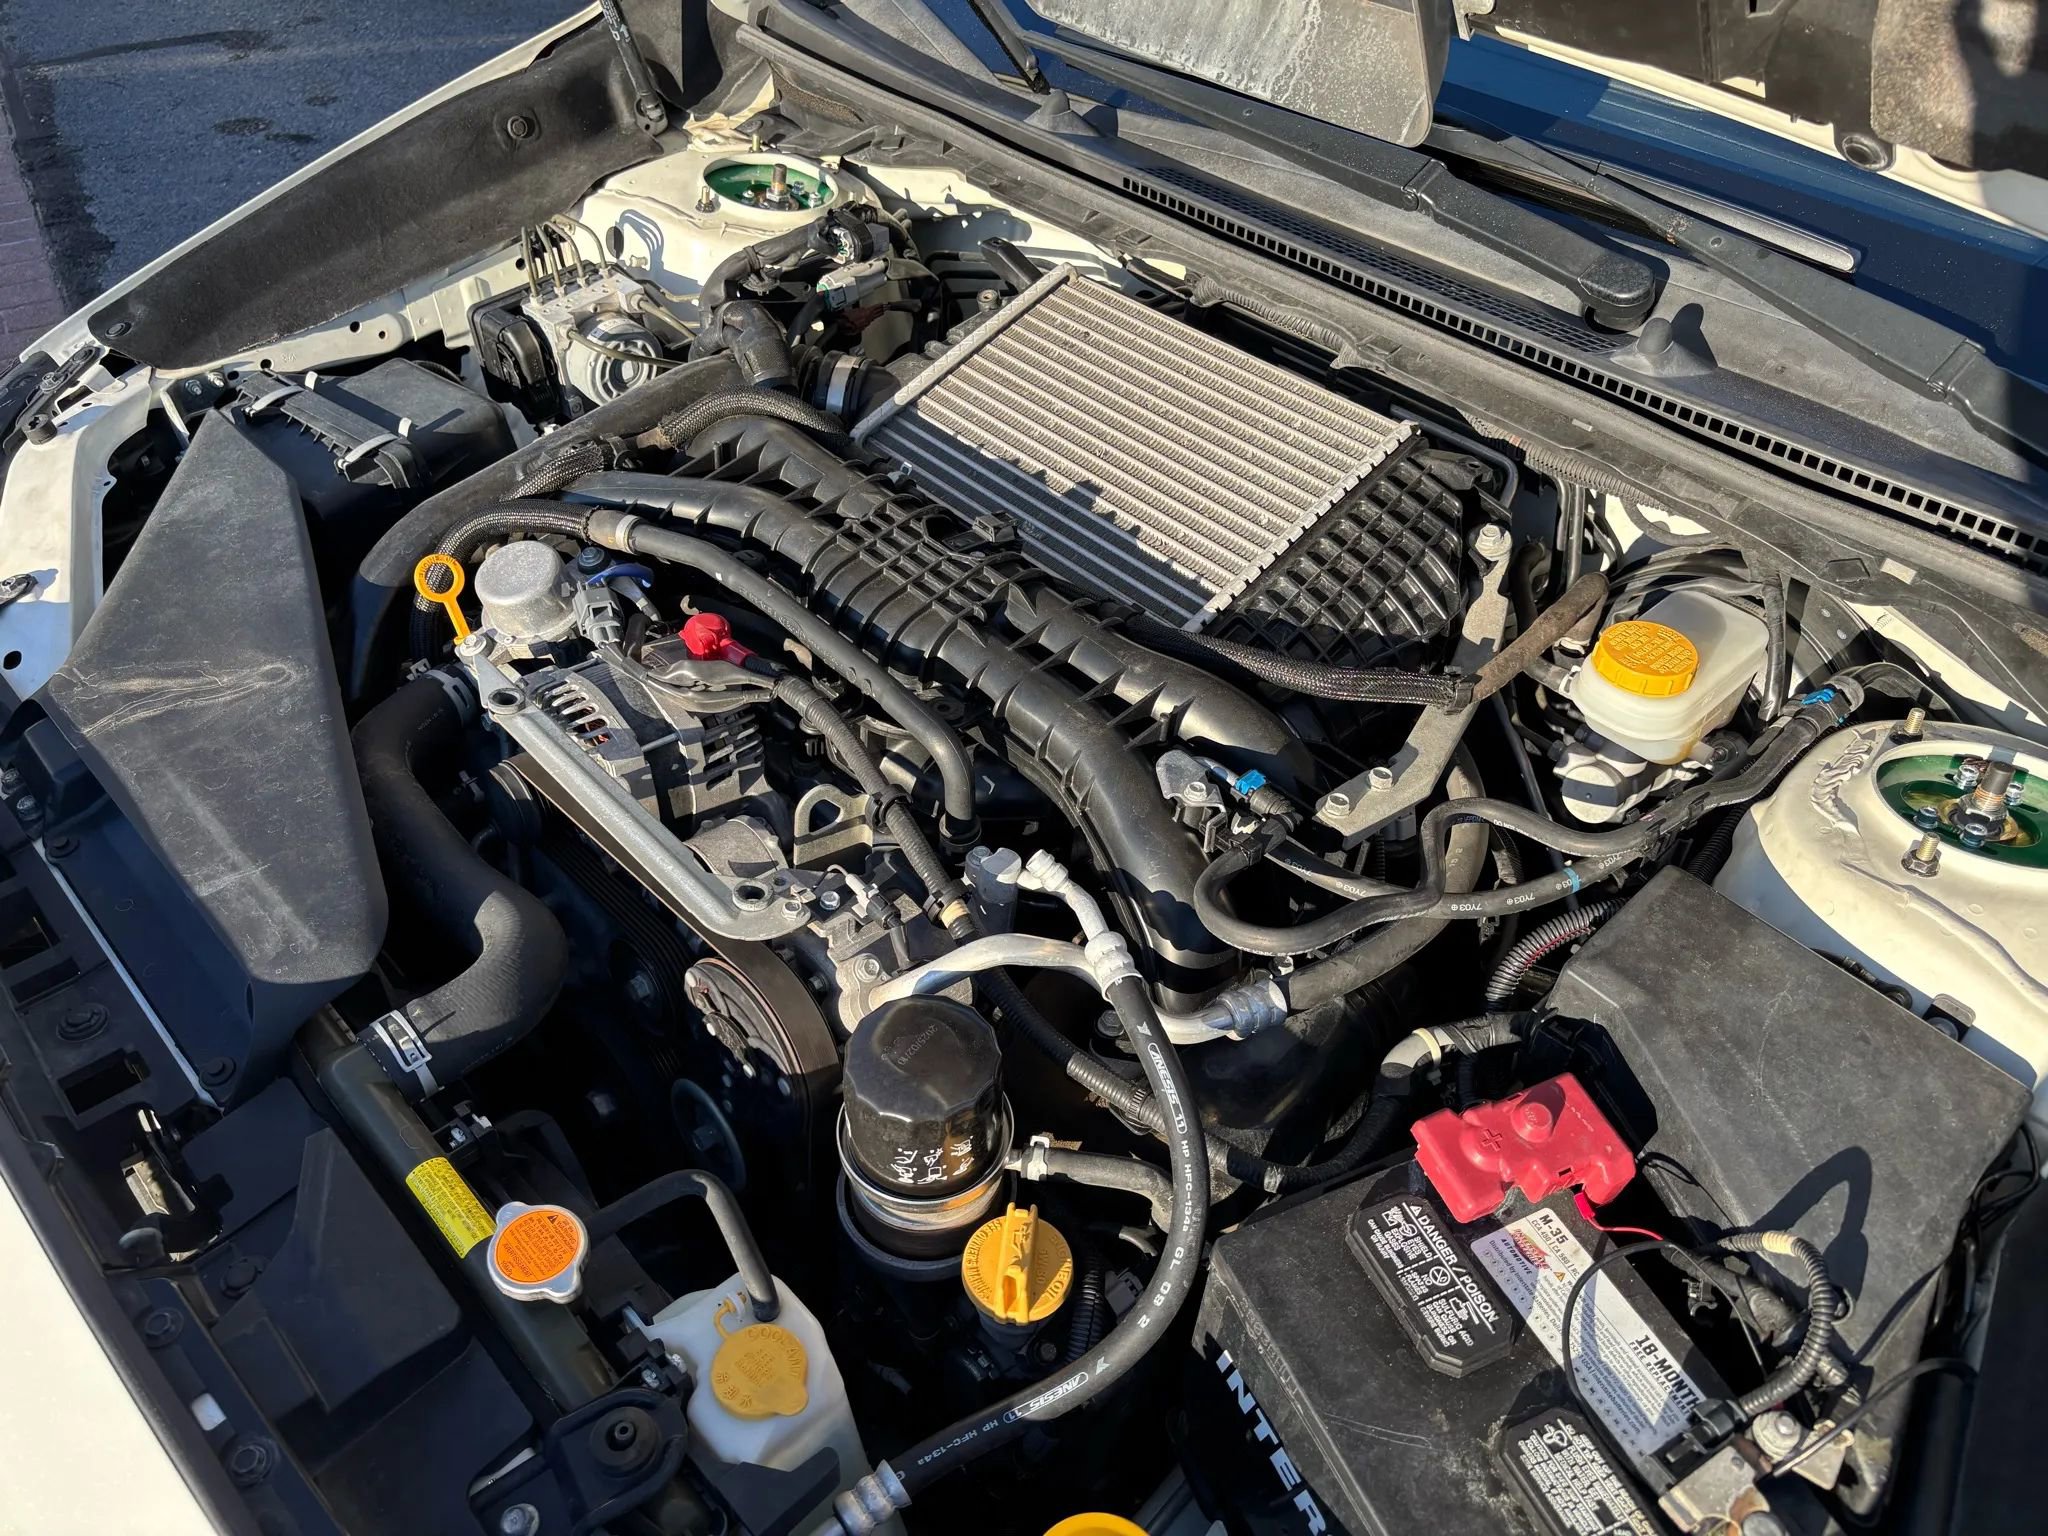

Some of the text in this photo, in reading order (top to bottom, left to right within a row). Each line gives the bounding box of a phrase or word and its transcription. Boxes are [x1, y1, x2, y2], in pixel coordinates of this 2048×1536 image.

[1459, 901, 1482, 912] 7Y03
[1513, 892, 1535, 903] 7Y03
[1180, 1139, 1191, 1158] HP
[1182, 1164, 1191, 1231] HFC-134a
[1383, 1229, 1401, 1251] GASES
[1389, 1226, 1416, 1261] EXPLOSIVE
[1531, 1218, 1543, 1231] CCA
[1551, 1244, 1561, 1254] CA
[1538, 1211, 1568, 1246] M-35
[1166, 1245, 1185, 1271] GL
[1406, 1238, 1421, 1256] EYES
[1412, 1235, 1432, 1259] SHIELD
[1500, 1235, 1532, 1277] AUTOMOTIVE
[1416, 1212, 1458, 1267] DANGER
[1458, 1272, 1499, 1325] POISON
[1420, 1272, 1432, 1286] NO
[1135, 1313, 1150, 1330] 2
[1431, 1300, 1443, 1313] CAN
[1437, 1297, 1462, 1331] SULFURIC
[1446, 1334, 1457, 1346] OR
[1488, 1239, 1511, 1265] Distributed
[1506, 1264, 1516, 1274] by
[1513, 1271, 1535, 1296] Interstate
[1580, 1357, 1593, 1371] USA
[1590, 1371, 1641, 1434] interstatebatteries.com
[1628, 1340, 1646, 1361] FREE
[1644, 1361, 1689, 1415] REPLACEMENT
[1634, 1332, 1702, 1411] 18-MONTH
[980, 1419, 998, 1432] HP
[913, 1428, 980, 1466] HFC-134a
[1215, 1349, 1328, 1536] INTER
[1546, 1458, 1558, 1473] FOR
[1554, 1471, 1568, 1488] SAFE
[1553, 1451, 1575, 1480] MEDICAL
[1571, 1477, 1587, 1496] HELP
[1567, 1444, 1585, 1466] FLUSH
[1581, 1463, 1596, 1482] EYES
[1587, 1486, 1600, 1502] GET
